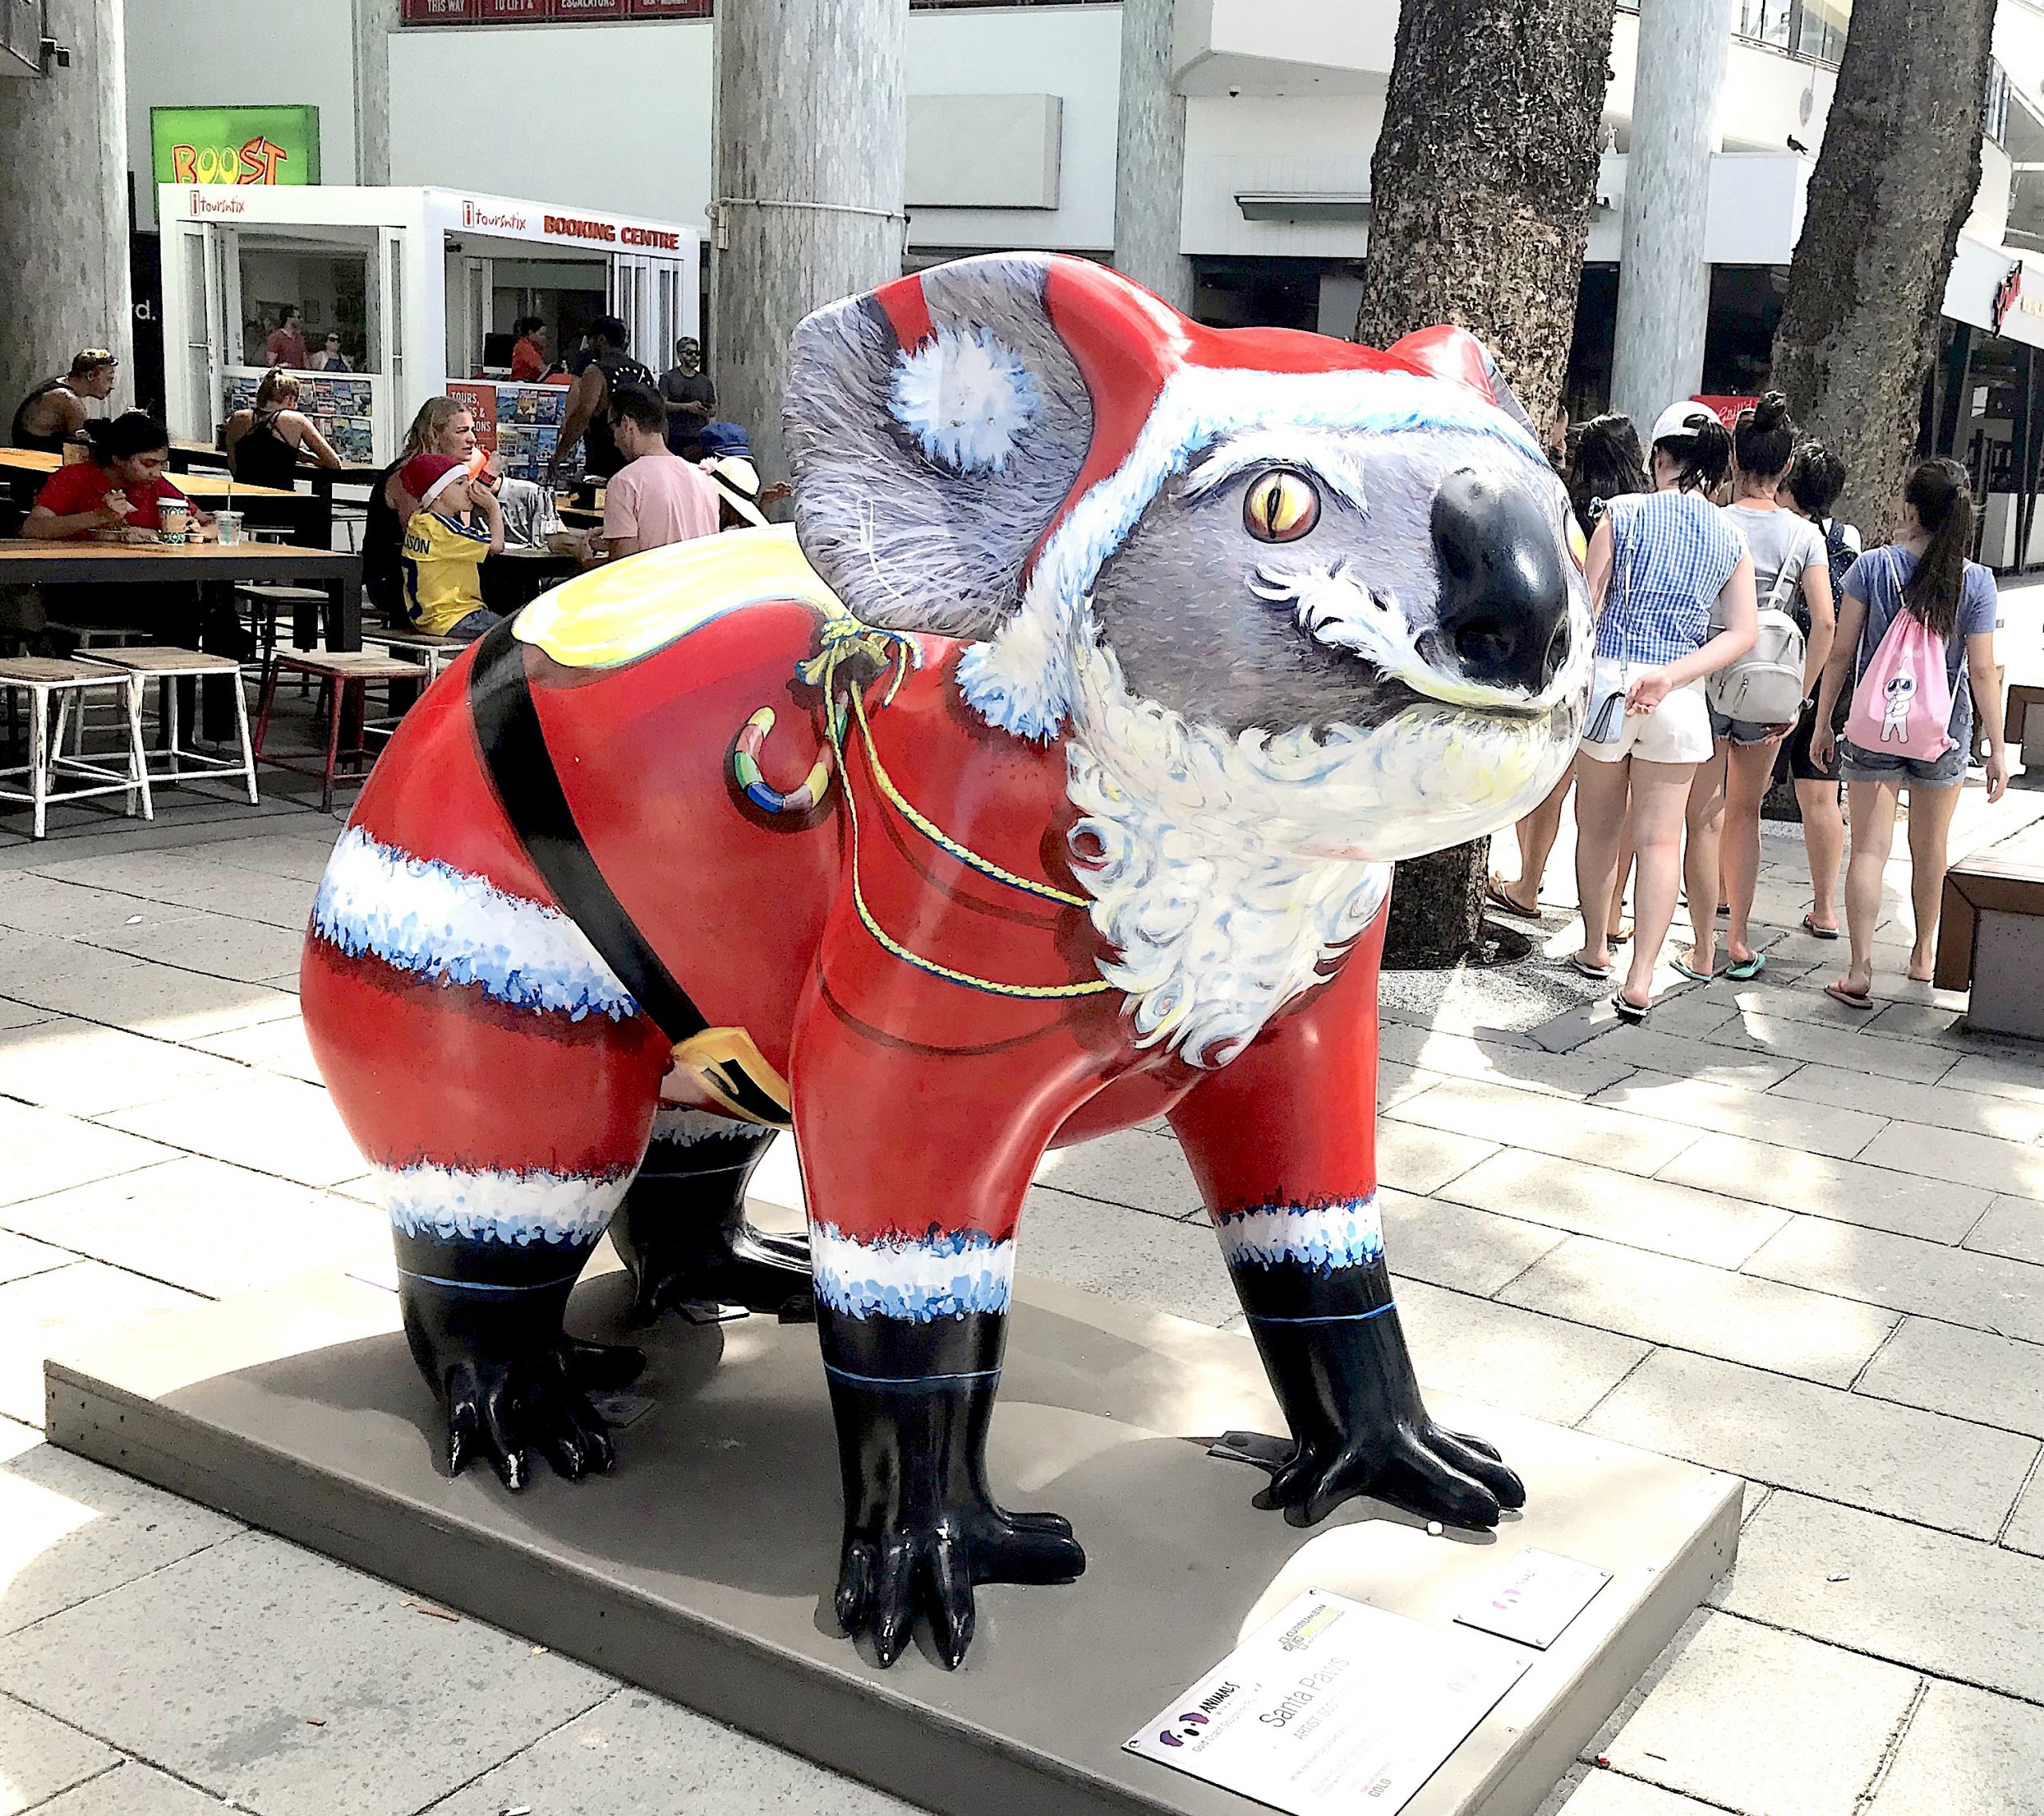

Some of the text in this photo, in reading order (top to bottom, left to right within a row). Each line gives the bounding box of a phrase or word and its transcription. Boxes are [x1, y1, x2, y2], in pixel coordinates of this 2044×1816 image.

[427, 0, 465, 13] THIS WAY
[173, 134, 288, 184] BOOST
[544, 215, 616, 242] BOOKING
[620, 227, 679, 250] CENTRE
[1285, 1604, 1327, 1637] CURRUMBIN
[1198, 1681, 1241, 1714] ANIMALS
[1258, 1691, 1315, 1727] Santa
[1298, 1657, 1349, 1691] Paws
[1293, 1715, 1322, 1740] ARTIST
[1368, 1778, 1392, 1798] GOLD
